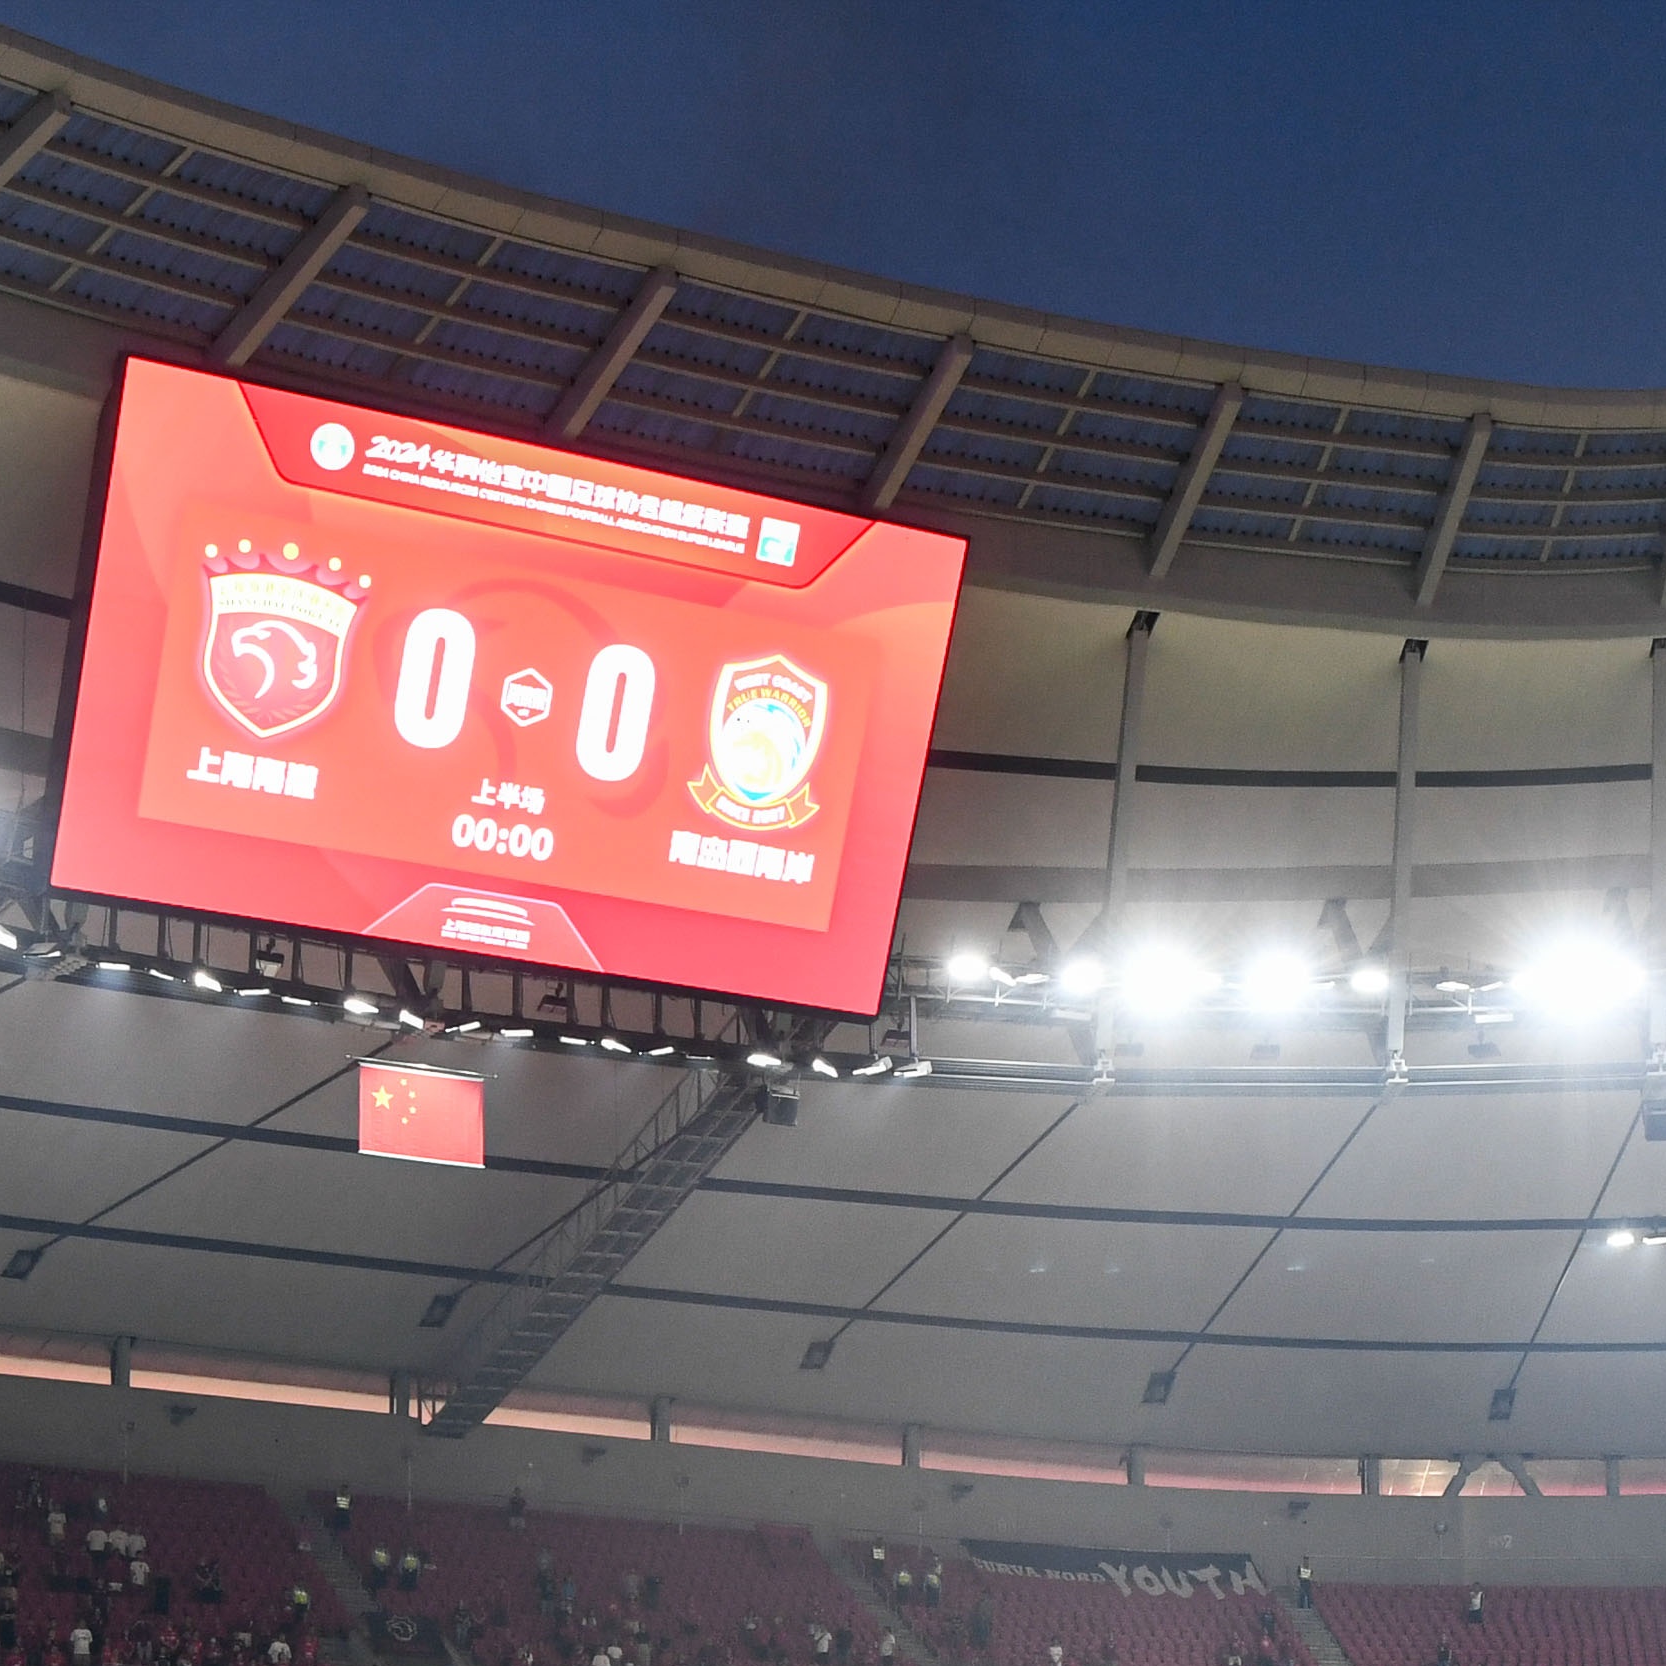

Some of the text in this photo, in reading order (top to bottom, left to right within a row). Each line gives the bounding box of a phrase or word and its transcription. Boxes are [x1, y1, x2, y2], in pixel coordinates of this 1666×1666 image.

[394, 608, 656, 782] 0 0
[760, 687, 812, 728] WARRIOR
[471, 777, 546, 815] 上半场
[451, 813, 554, 861] 00:00
[1097, 1560, 1270, 1601] YOUTH
